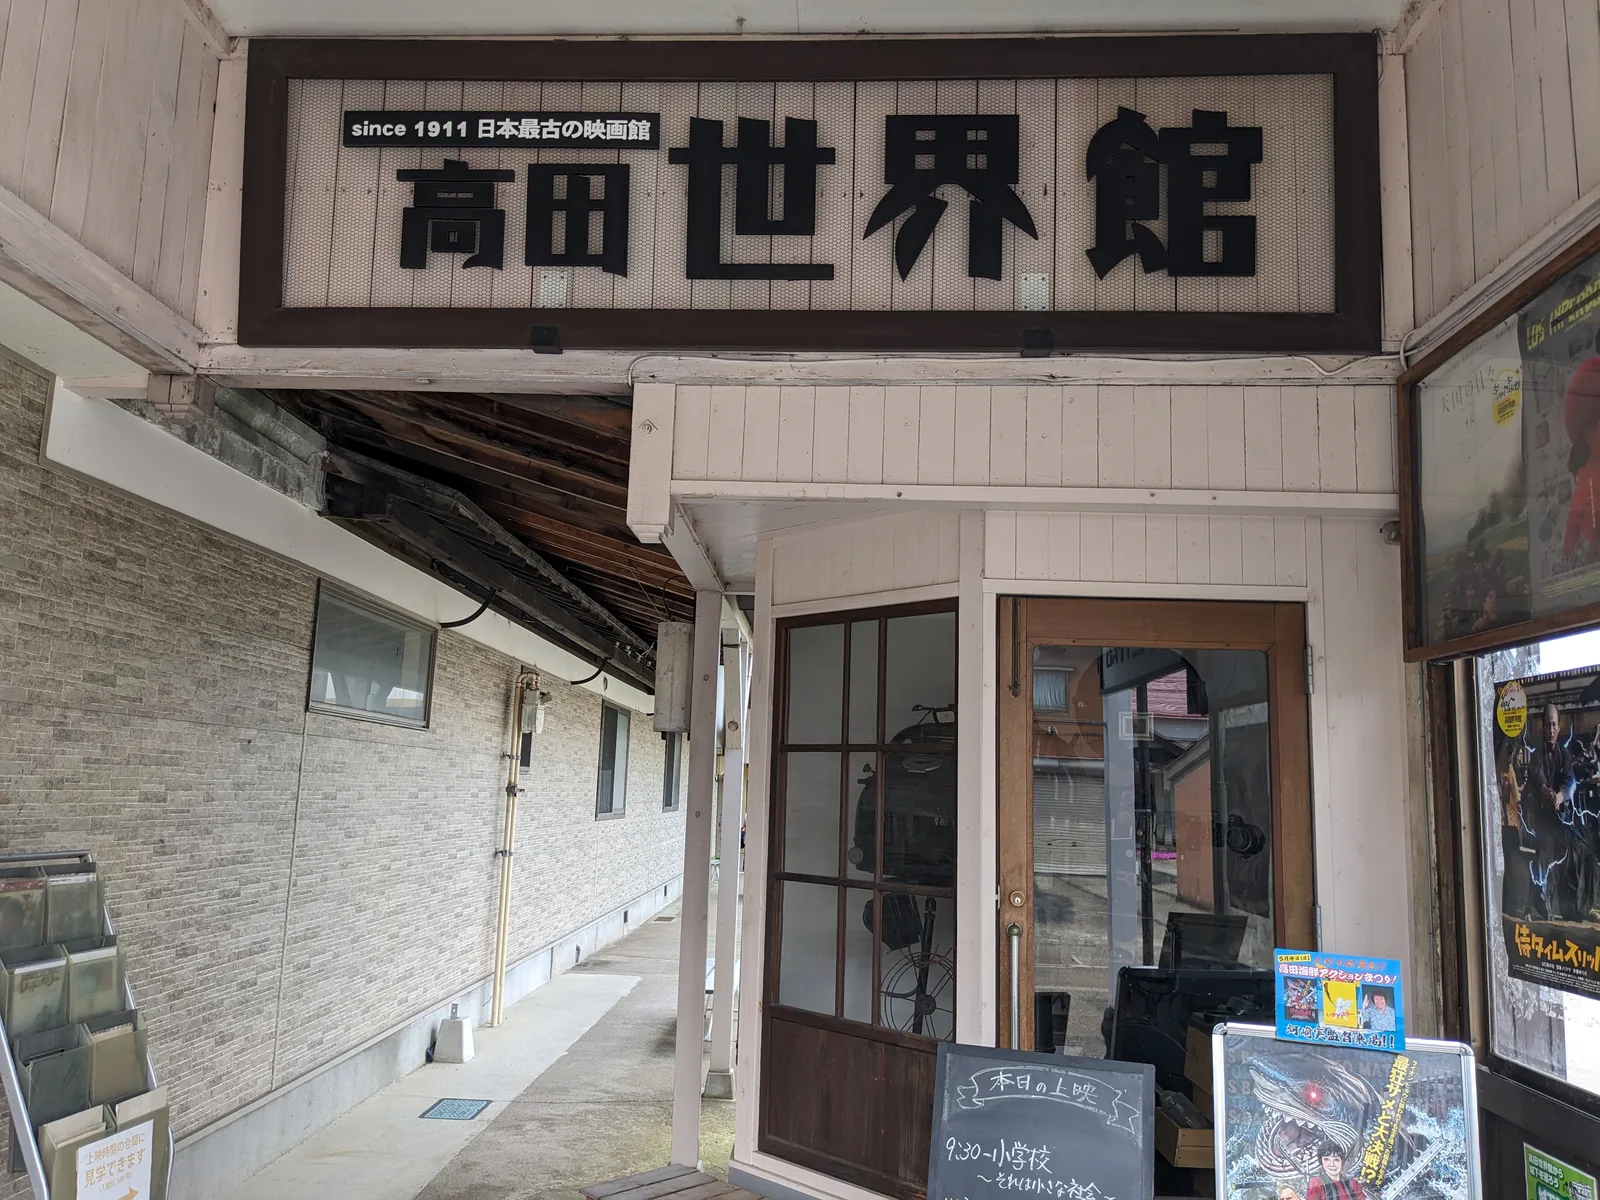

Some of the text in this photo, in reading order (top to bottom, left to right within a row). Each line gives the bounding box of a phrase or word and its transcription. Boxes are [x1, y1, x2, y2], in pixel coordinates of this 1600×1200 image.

[351, 117, 652, 142] since 1911 日本最古の映画館
[397, 107, 1264, 282] 高田世界館
[1440, 366, 1495, 414] 天国の日々
[1514, 922, 1600, 973] 侍タイムスリッ
[989, 1071, 1100, 1105] 本日の上映
[84, 1147, 146, 1188] 見学できます
